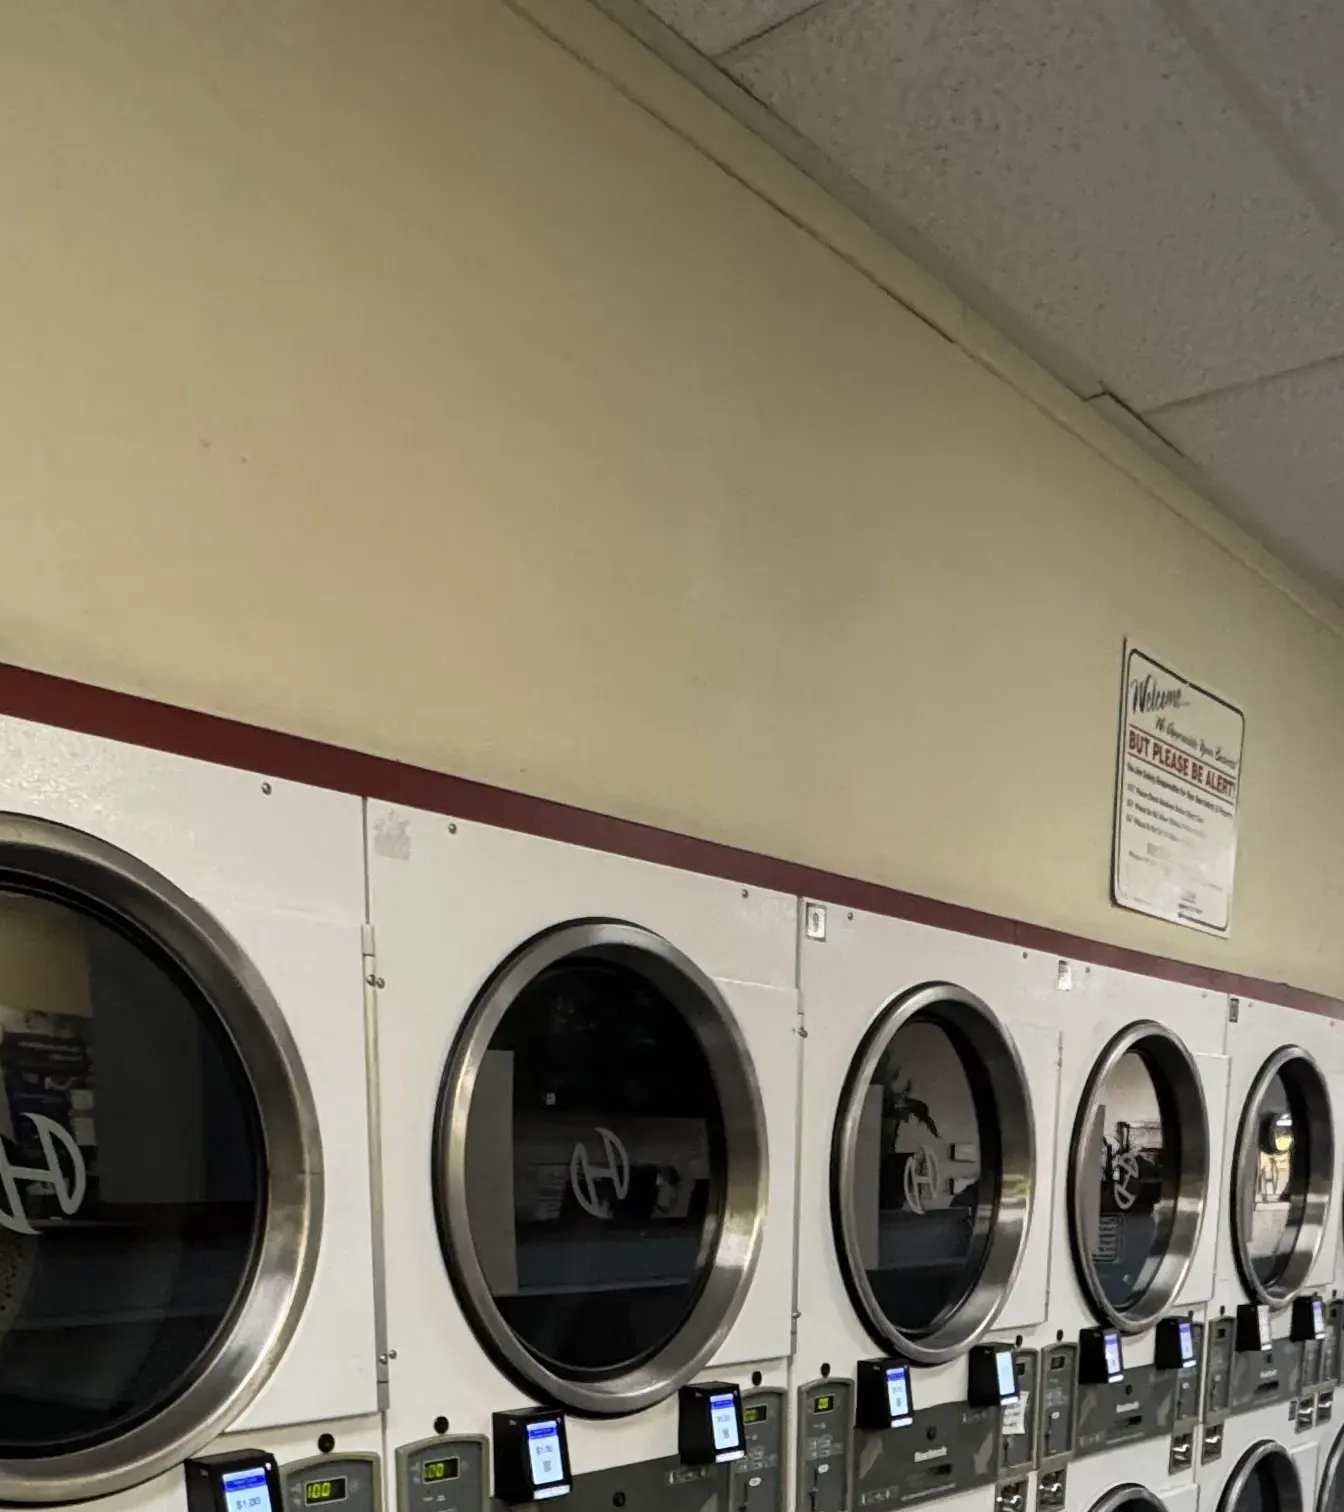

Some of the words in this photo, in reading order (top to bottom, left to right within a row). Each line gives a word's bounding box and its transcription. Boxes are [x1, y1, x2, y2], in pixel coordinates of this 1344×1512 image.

[1128, 729, 1150, 758] BUT
[1152, 741, 1189, 777] PLEASE
[1191, 761, 1204, 784] BE
[1205, 769, 1236, 799] ALERT!
[307, 1482, 331, 1499] 100
